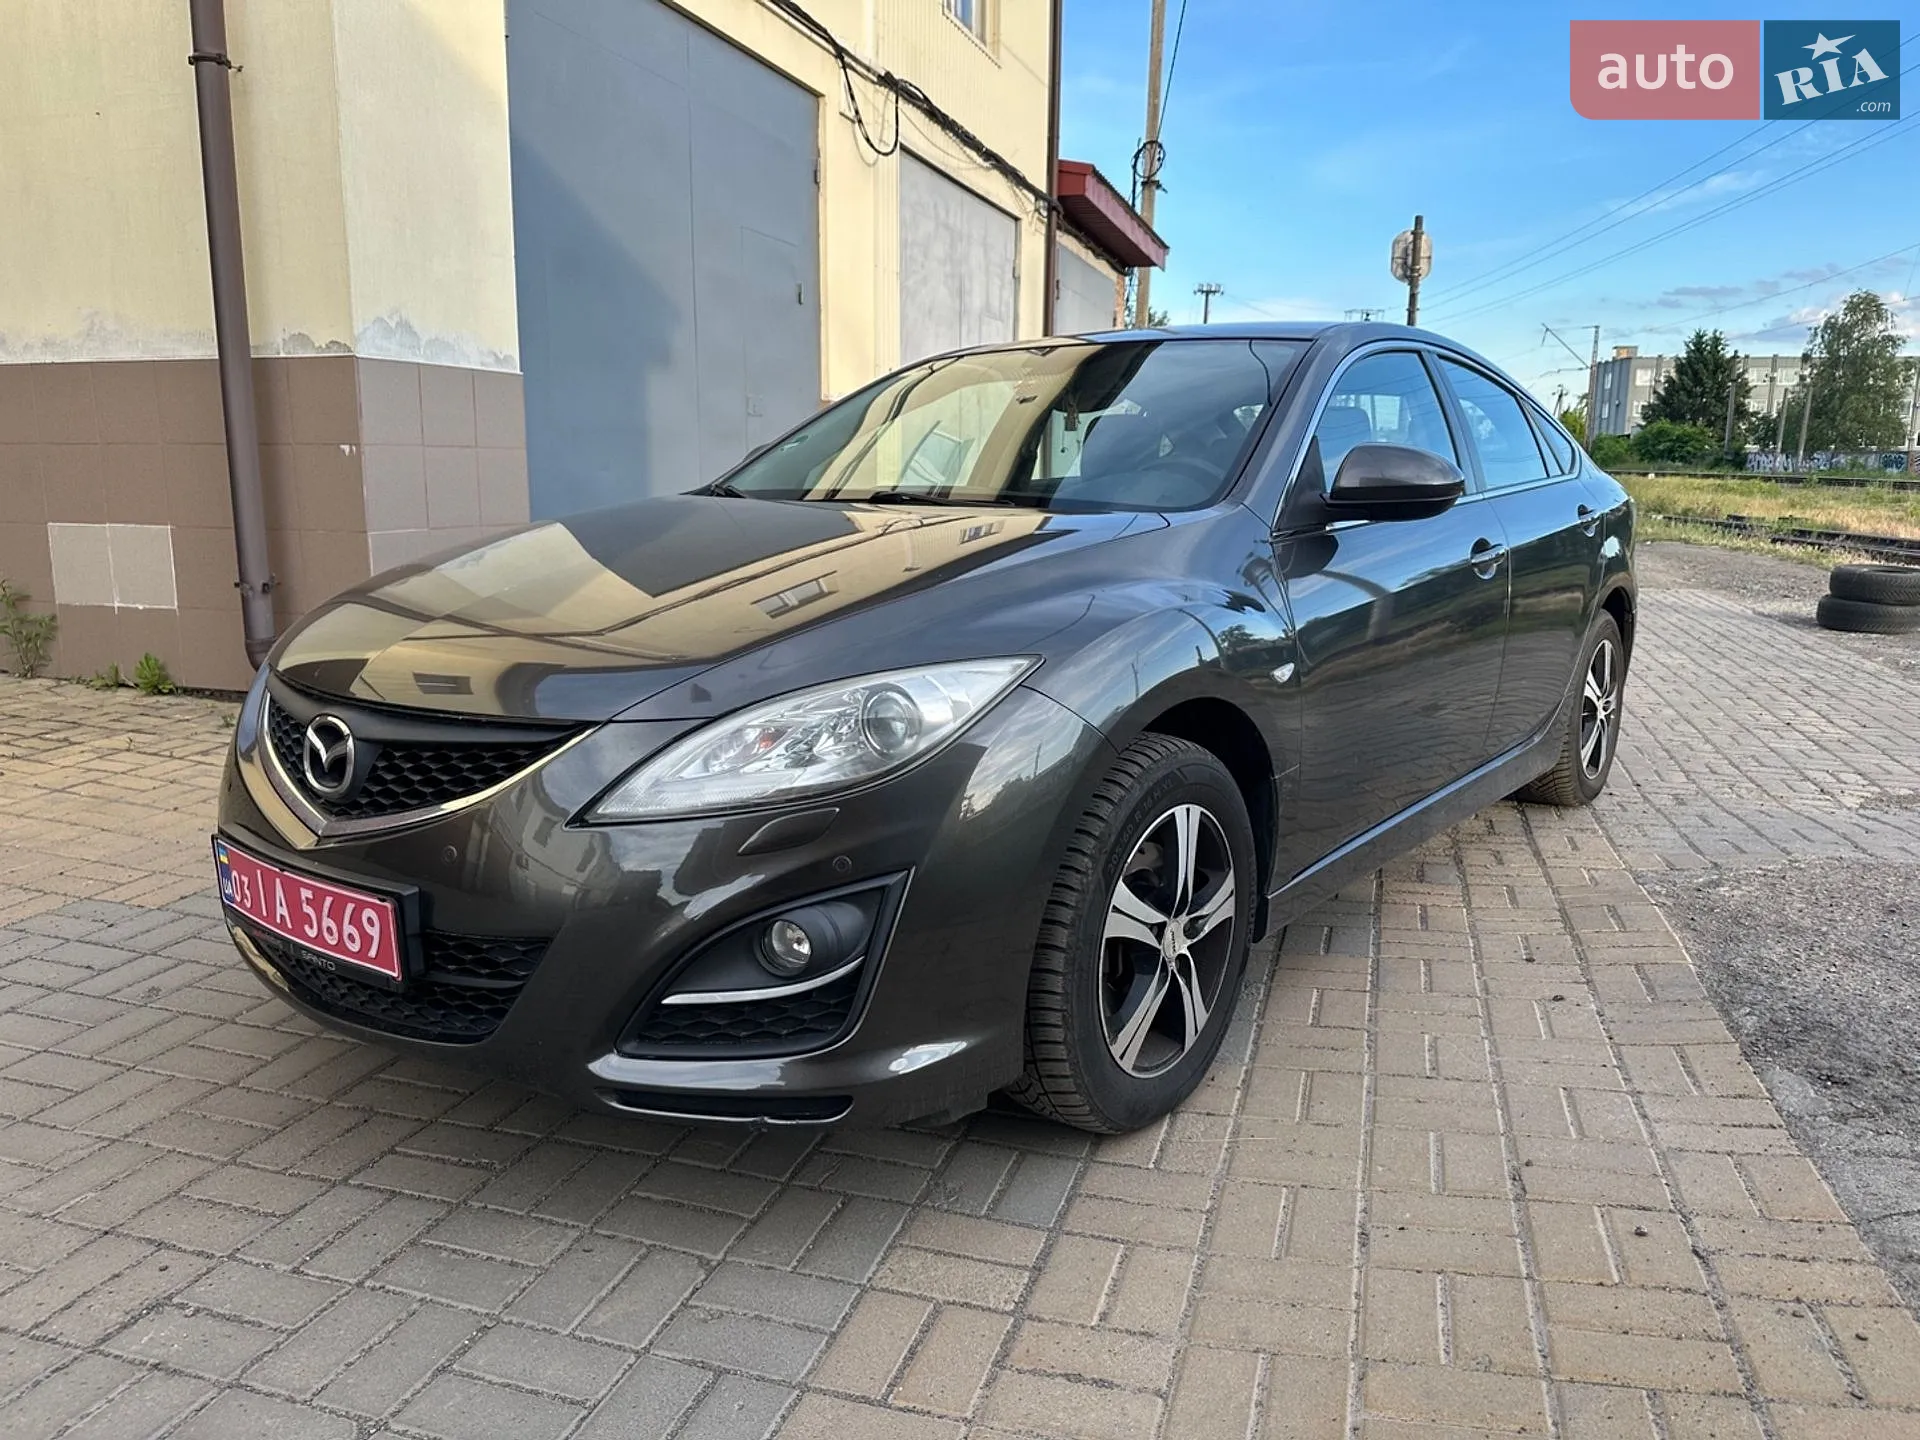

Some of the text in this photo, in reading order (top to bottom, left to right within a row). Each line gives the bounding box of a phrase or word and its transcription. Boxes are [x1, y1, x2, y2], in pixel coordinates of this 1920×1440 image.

[222, 877, 233, 895] UA
[231, 870, 251, 908] 03
[300, 887, 381, 959] 5669
